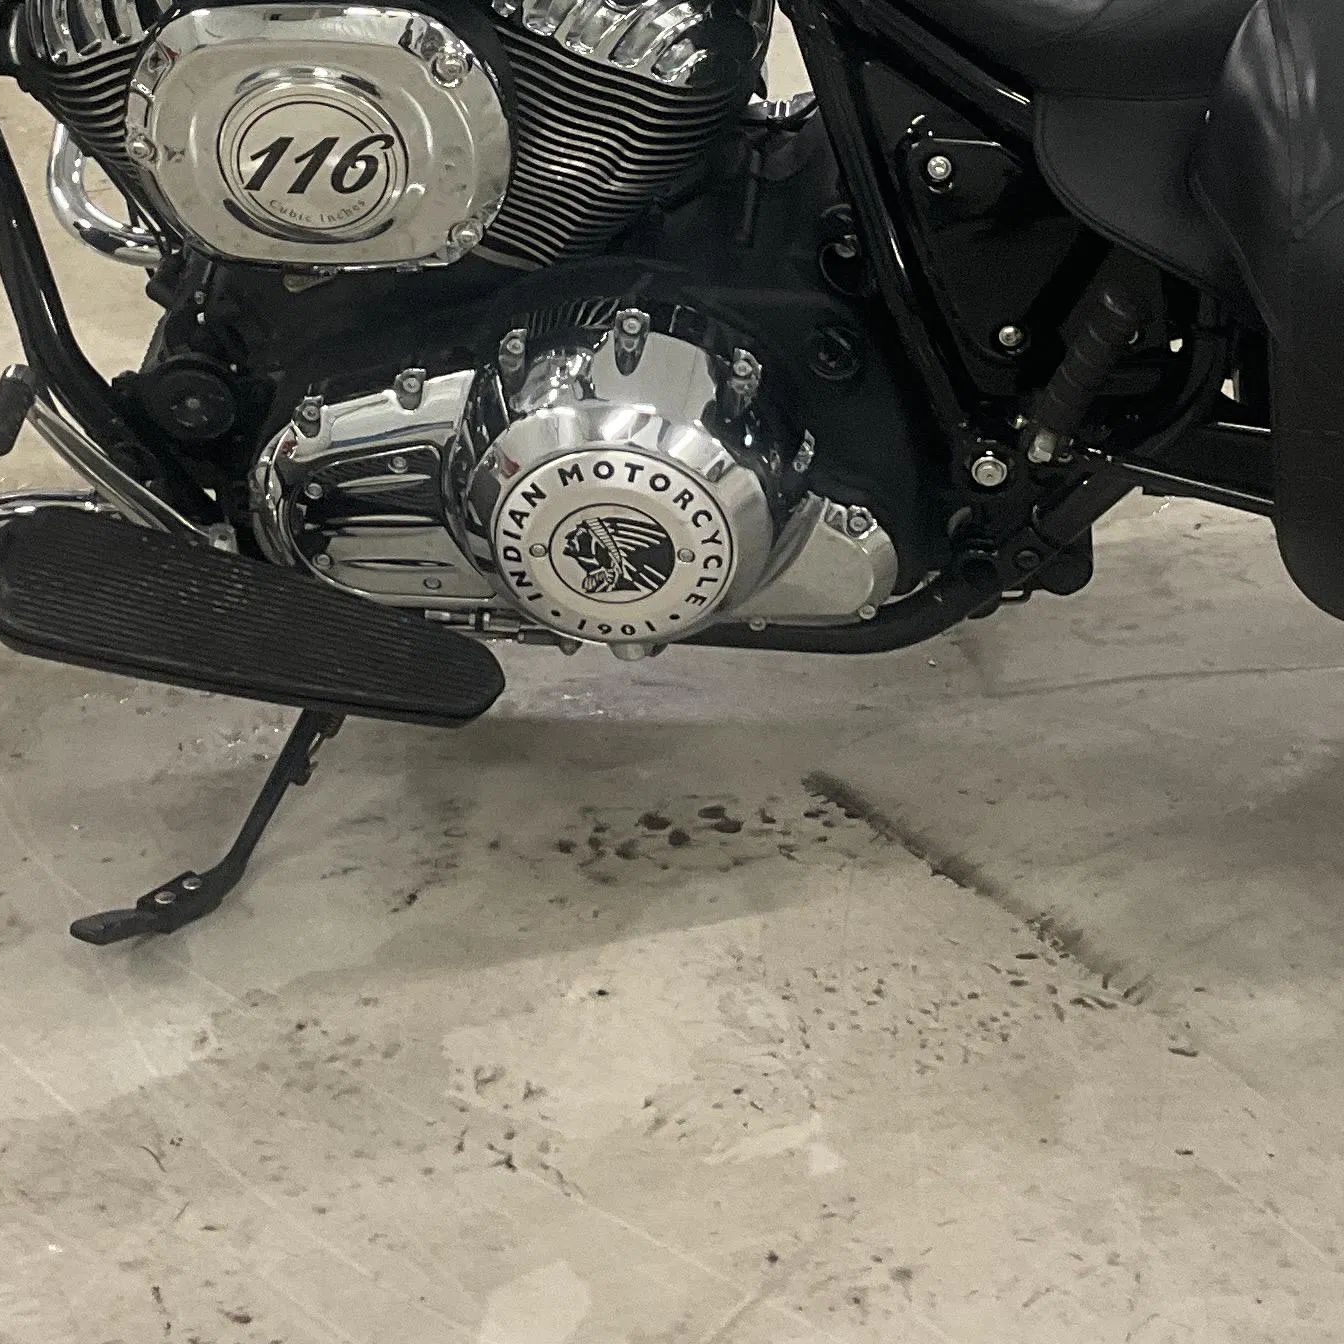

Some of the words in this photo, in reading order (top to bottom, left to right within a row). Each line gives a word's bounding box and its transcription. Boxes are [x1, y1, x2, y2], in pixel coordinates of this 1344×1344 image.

[244, 133, 395, 195] 116
[269, 199, 312, 223] Cubic
[319, 199, 366, 223] Inches
[502, 481, 548, 602] INDIAN
[557, 460, 724, 607] MOTORCYCLE
[577, 619, 657, 637] 1901
